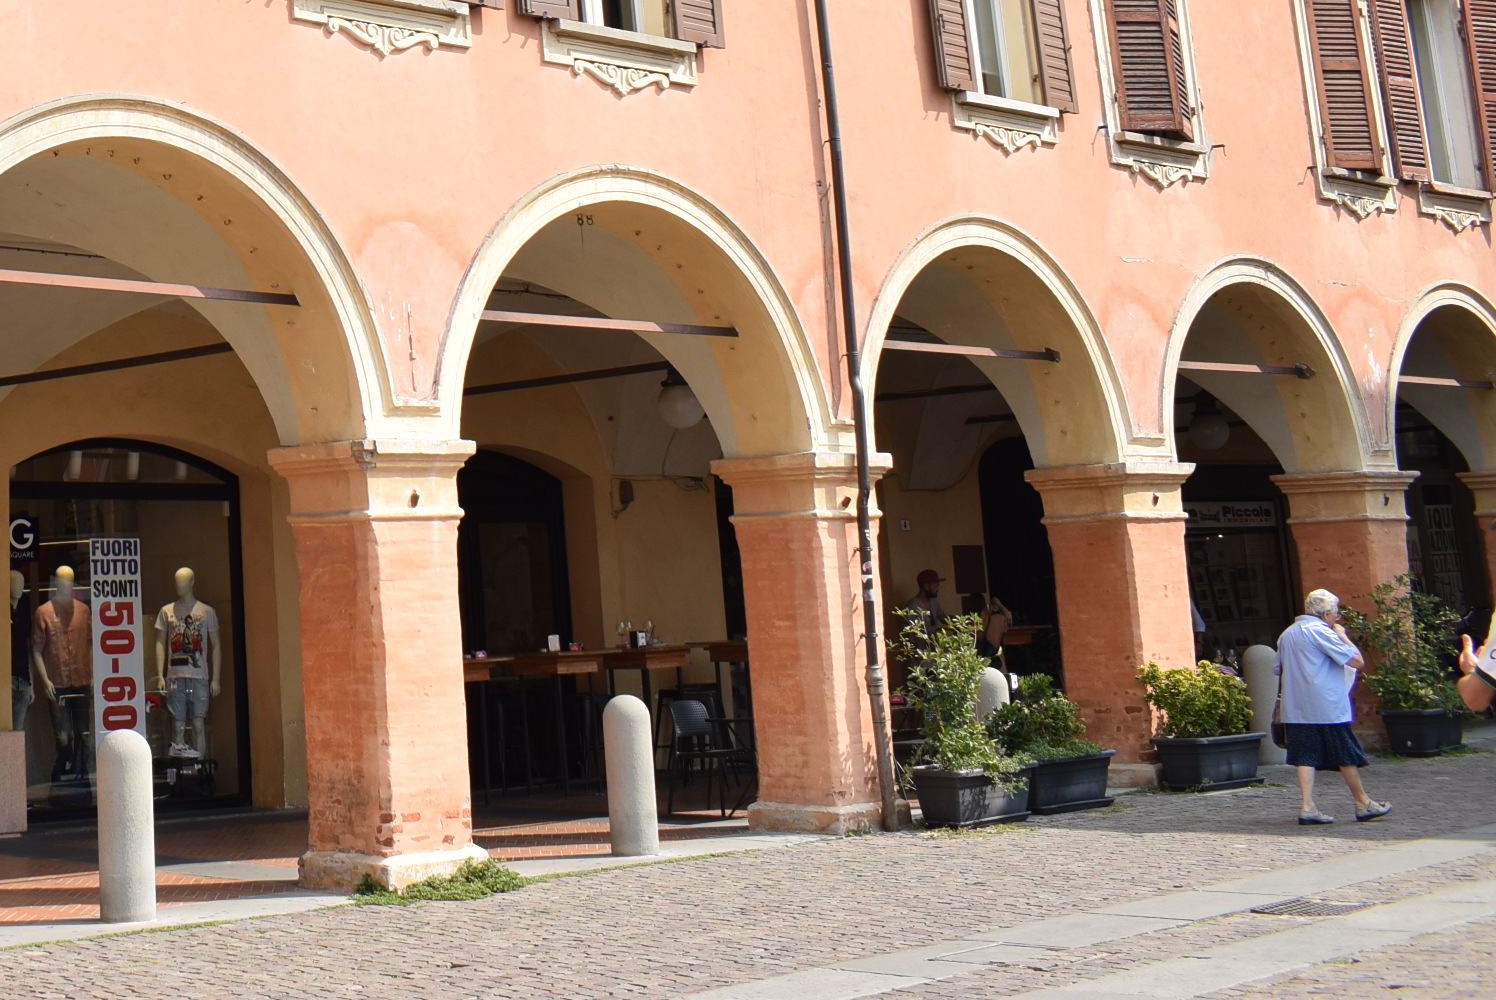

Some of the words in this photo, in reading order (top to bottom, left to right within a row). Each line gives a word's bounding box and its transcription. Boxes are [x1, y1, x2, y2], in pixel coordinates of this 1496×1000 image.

[10, 519, 34, 549] G
[91, 540, 138, 556] FUORI
[91, 559, 138, 576] TUTTO
[93, 579, 138, 598] SCONTI
[99, 600, 138, 731] 50-60
